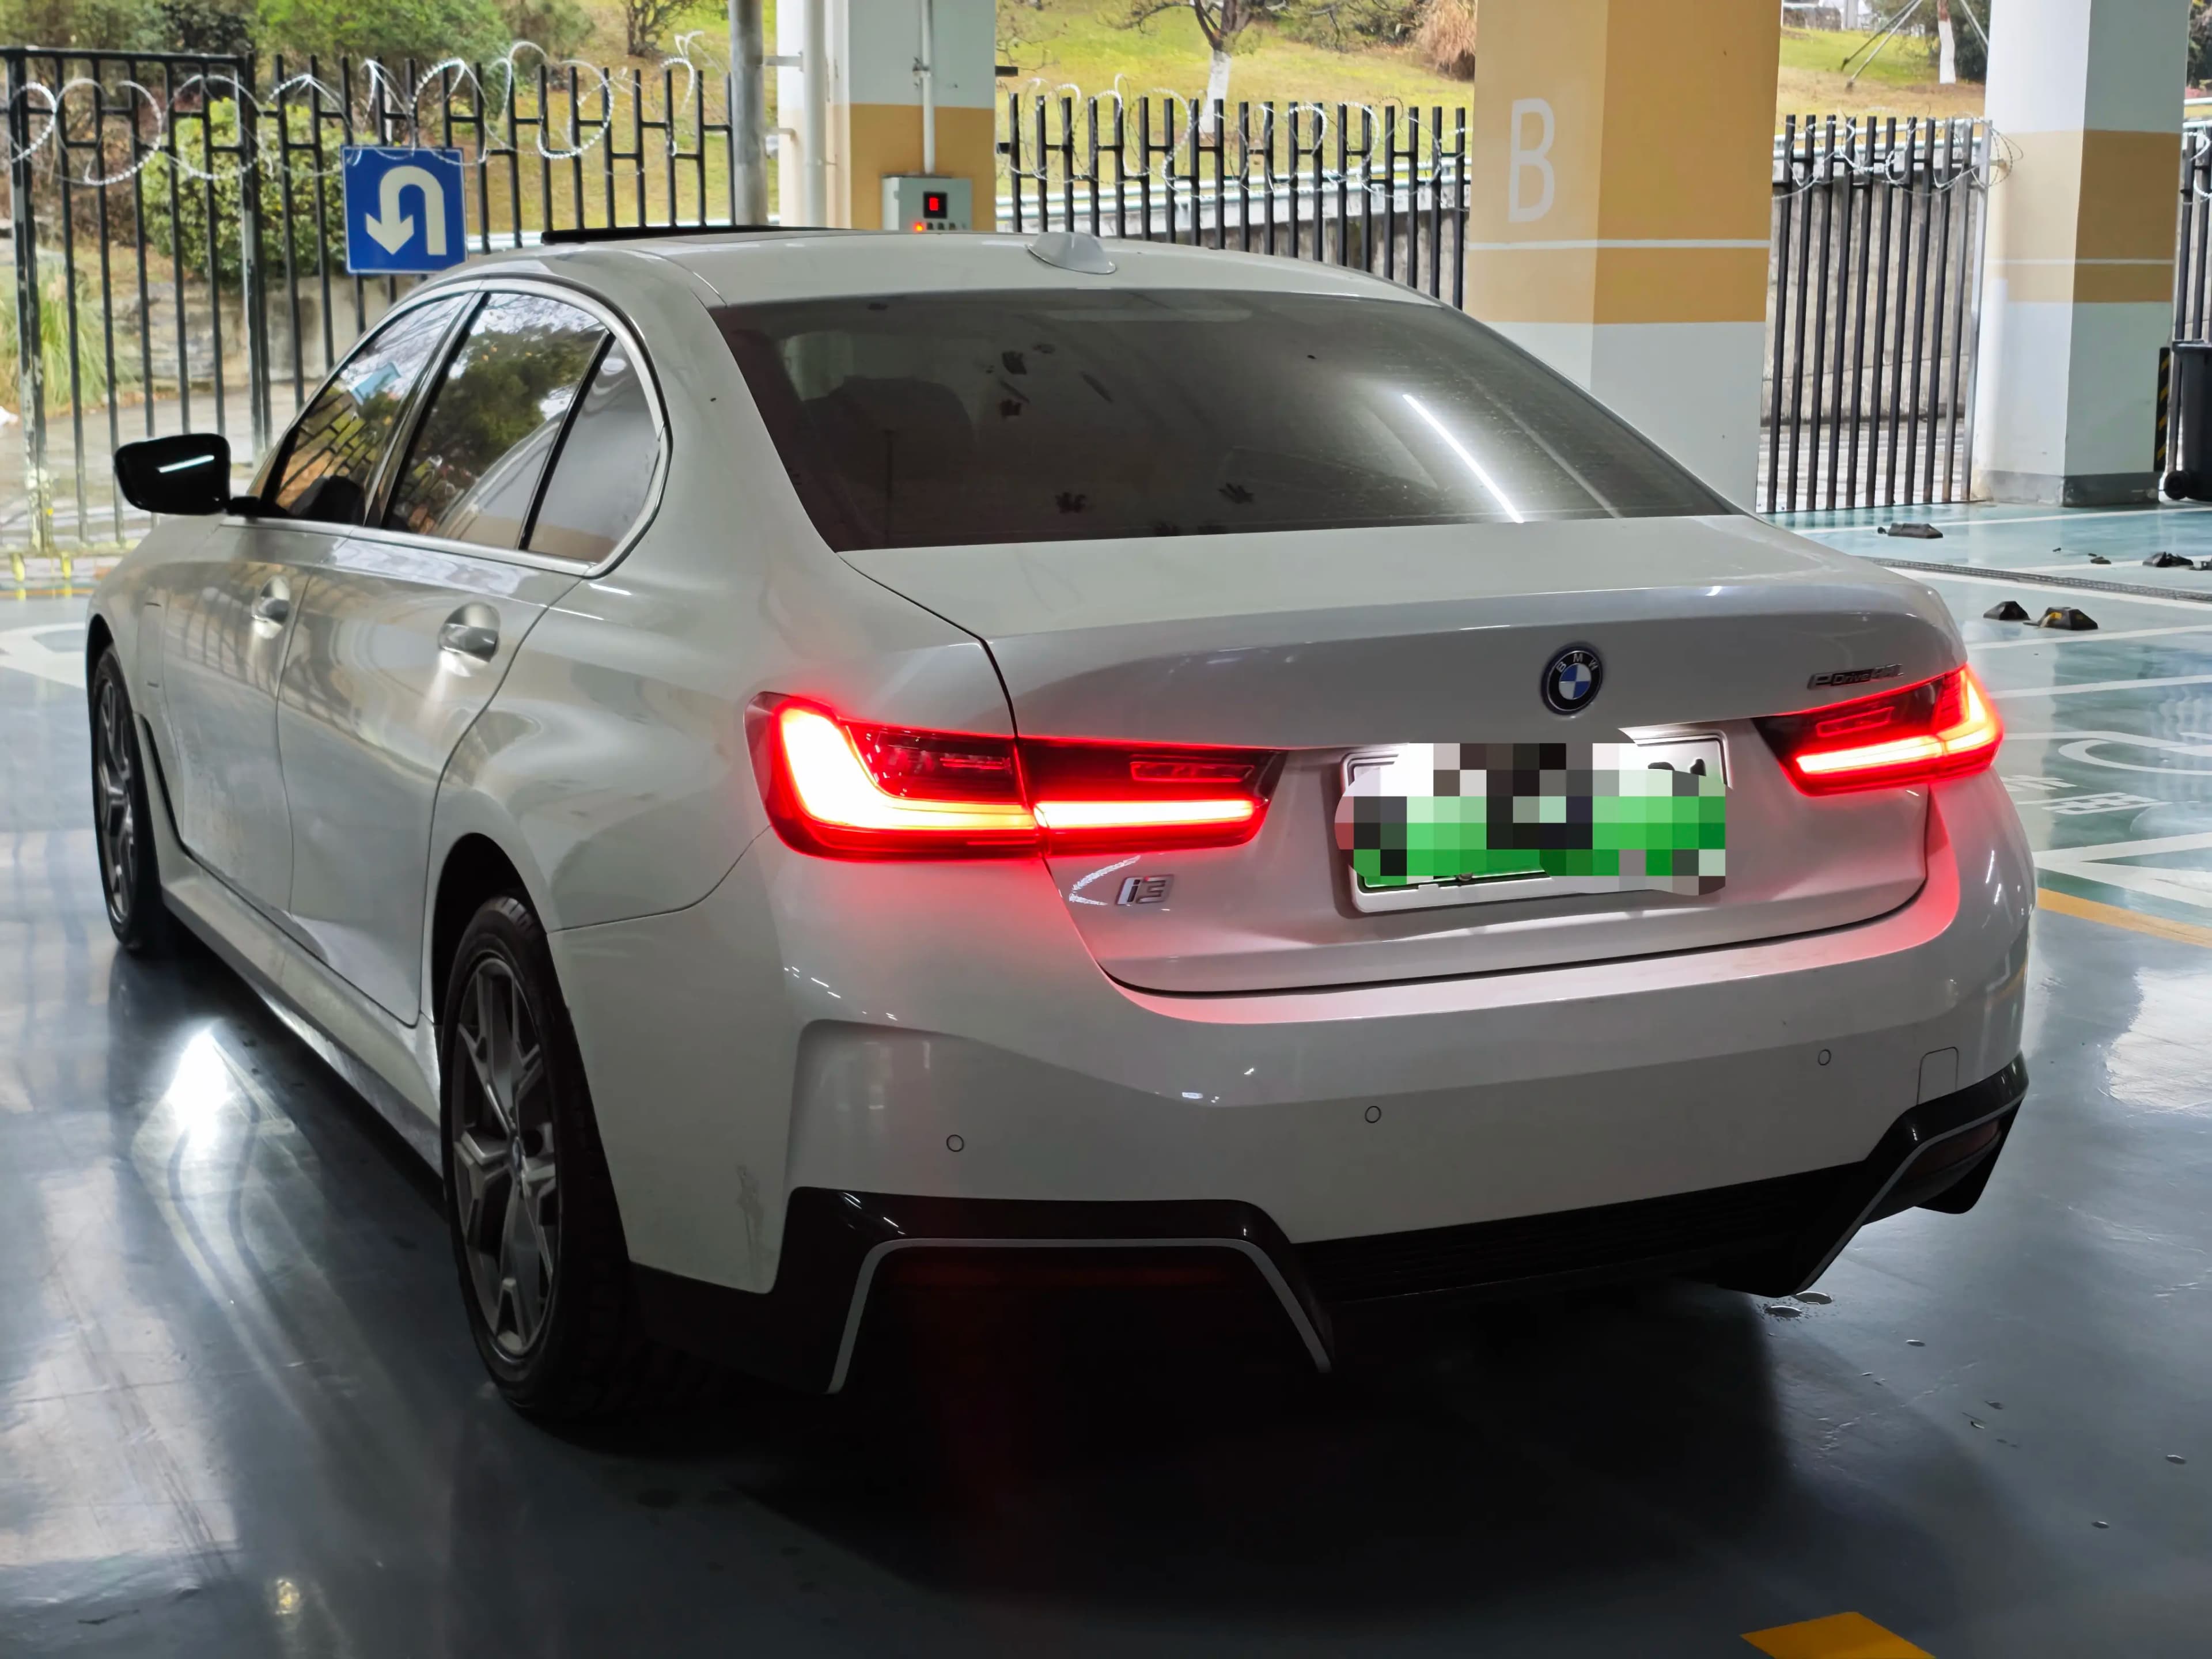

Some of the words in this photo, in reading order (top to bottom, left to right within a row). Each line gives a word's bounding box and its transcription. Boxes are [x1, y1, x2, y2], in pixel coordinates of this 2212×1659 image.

[1508, 97, 1555, 223] B
[1556, 653, 1599, 673] BMW
[1115, 874, 1175, 905] i3
